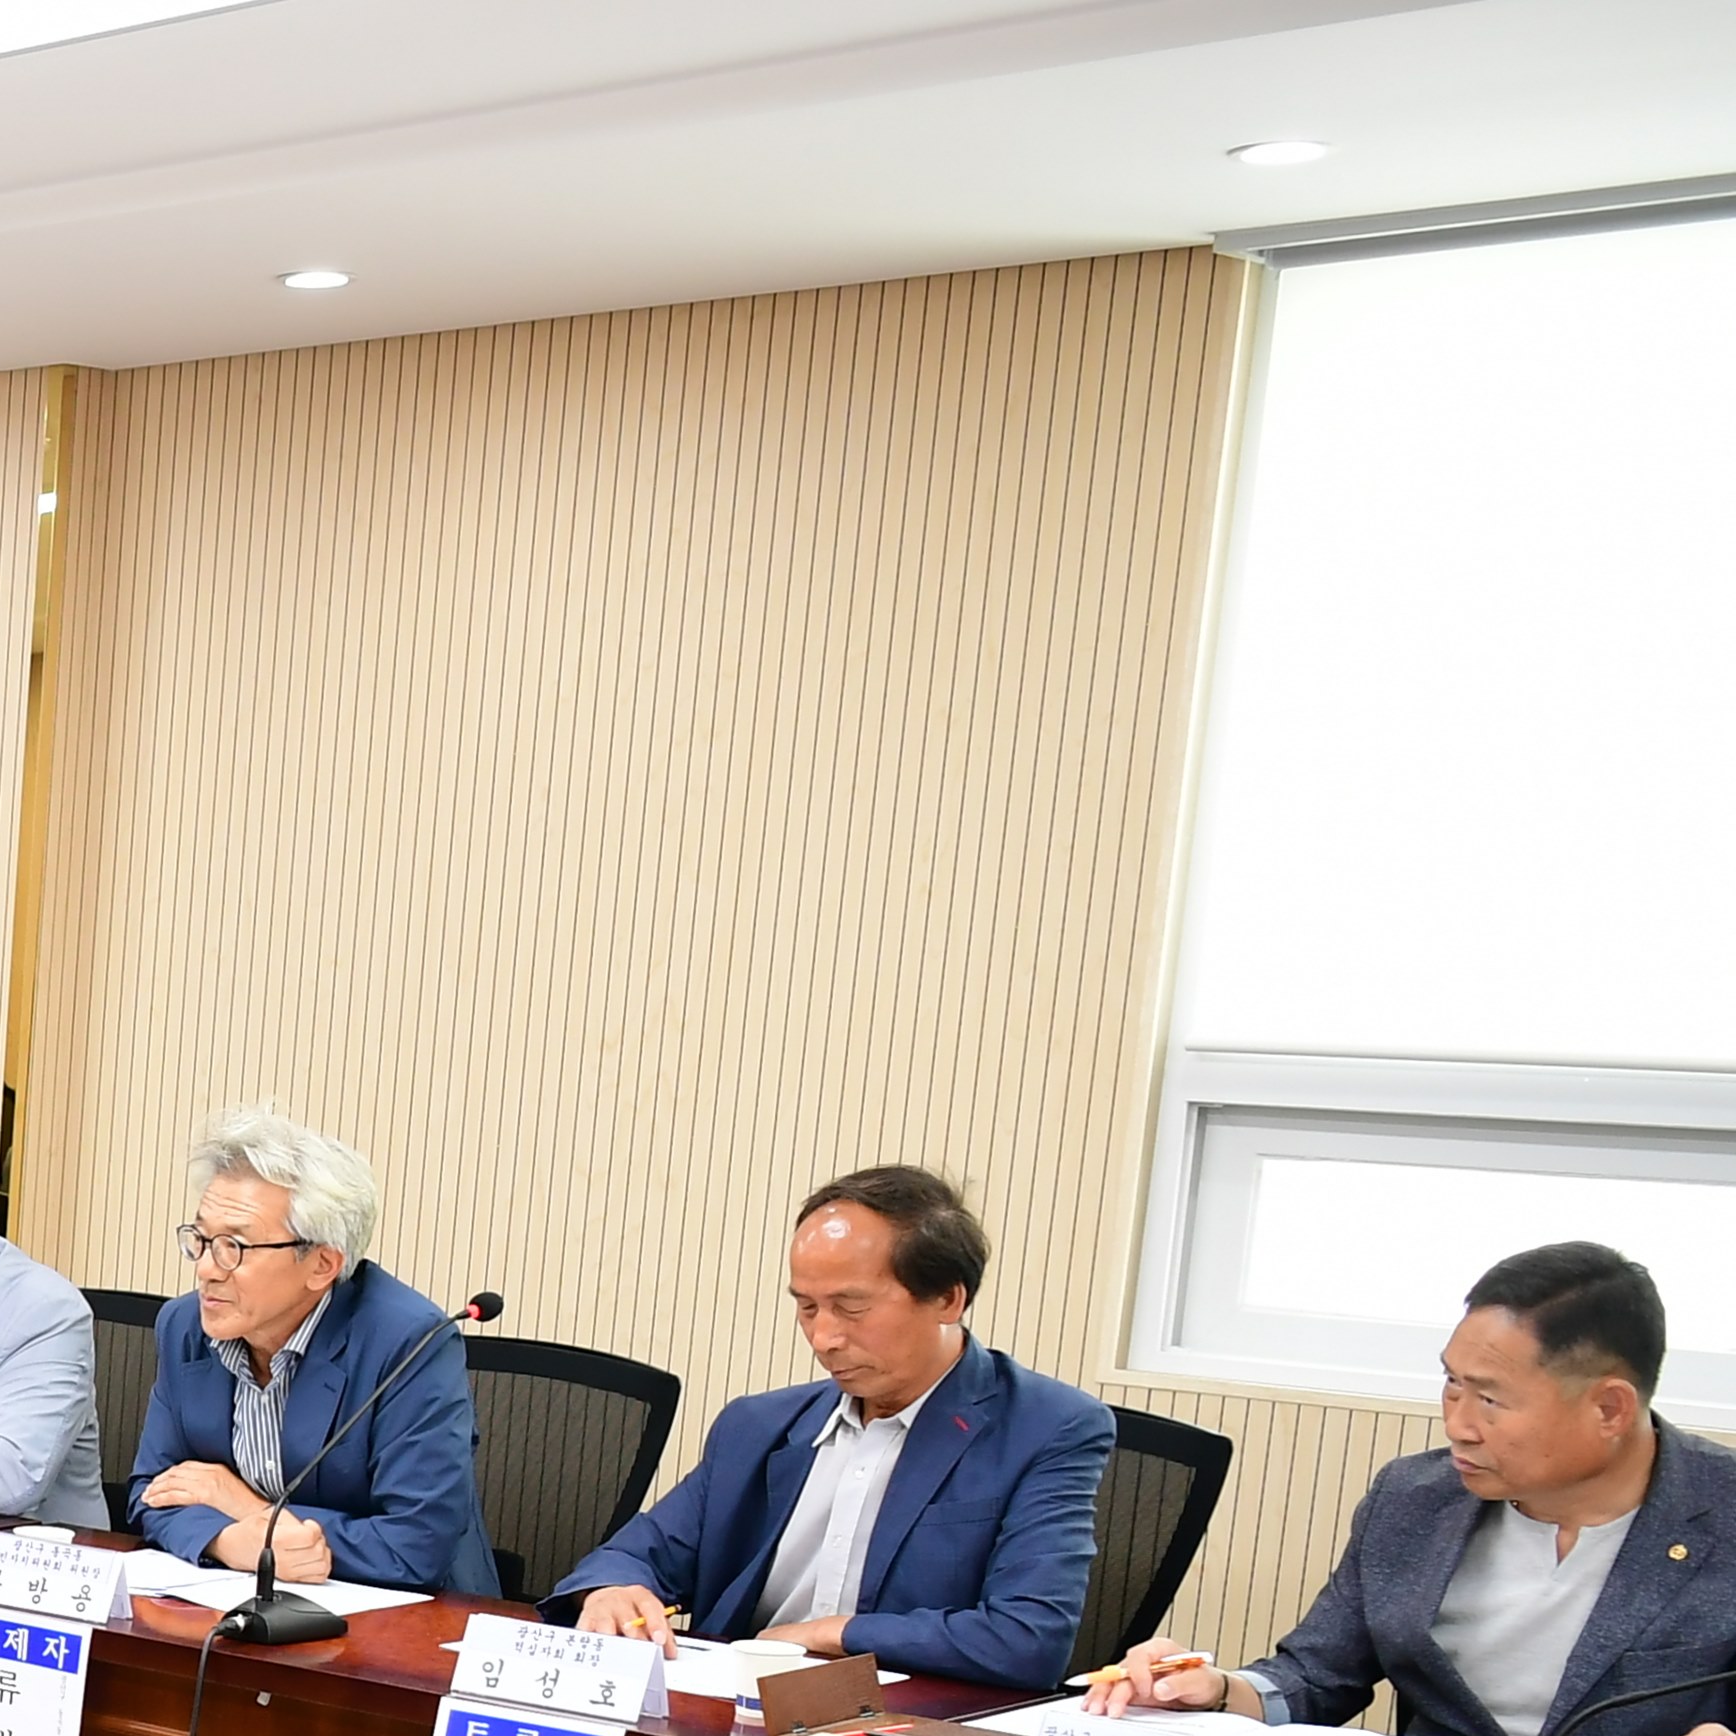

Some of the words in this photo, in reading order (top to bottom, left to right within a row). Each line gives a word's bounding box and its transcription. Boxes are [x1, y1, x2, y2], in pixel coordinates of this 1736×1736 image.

[517, 1625, 556, 1641] 광산구
[574, 1651, 601, 1668] 회장
[482, 1658, 616, 1708] 임성호
